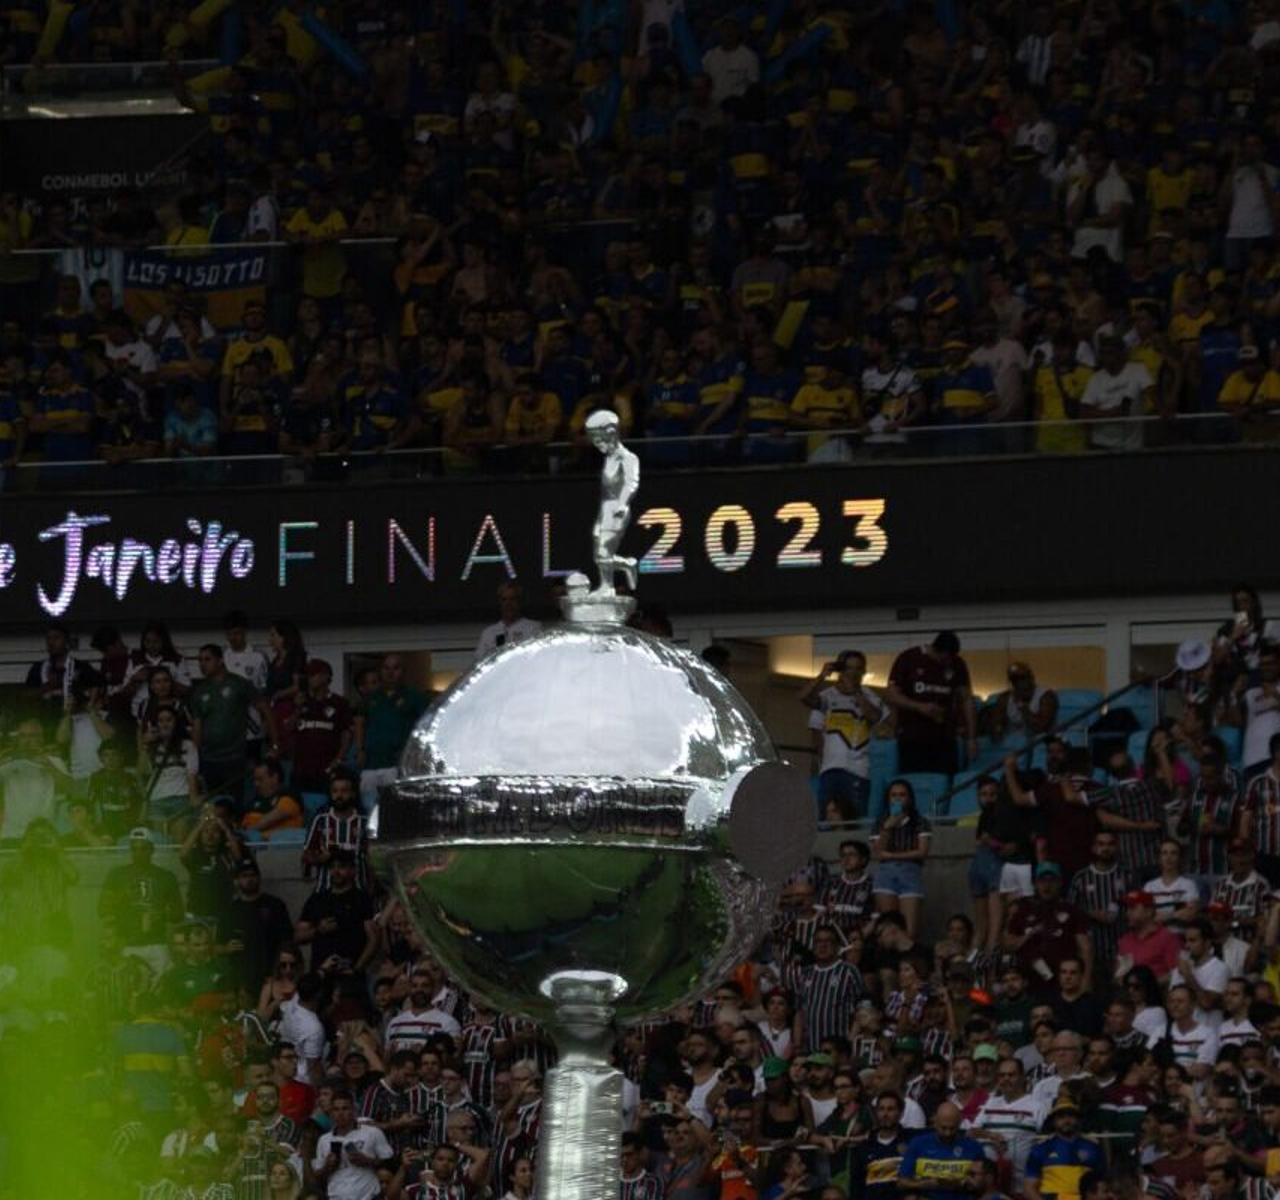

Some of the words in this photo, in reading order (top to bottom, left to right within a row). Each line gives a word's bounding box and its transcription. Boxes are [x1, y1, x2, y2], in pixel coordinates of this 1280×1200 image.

[127, 259, 169, 284] LOS
[36, 509, 256, 618] Janeiro
[278, 512, 580, 588] FINAL
[635, 496, 892, 576] 2023
